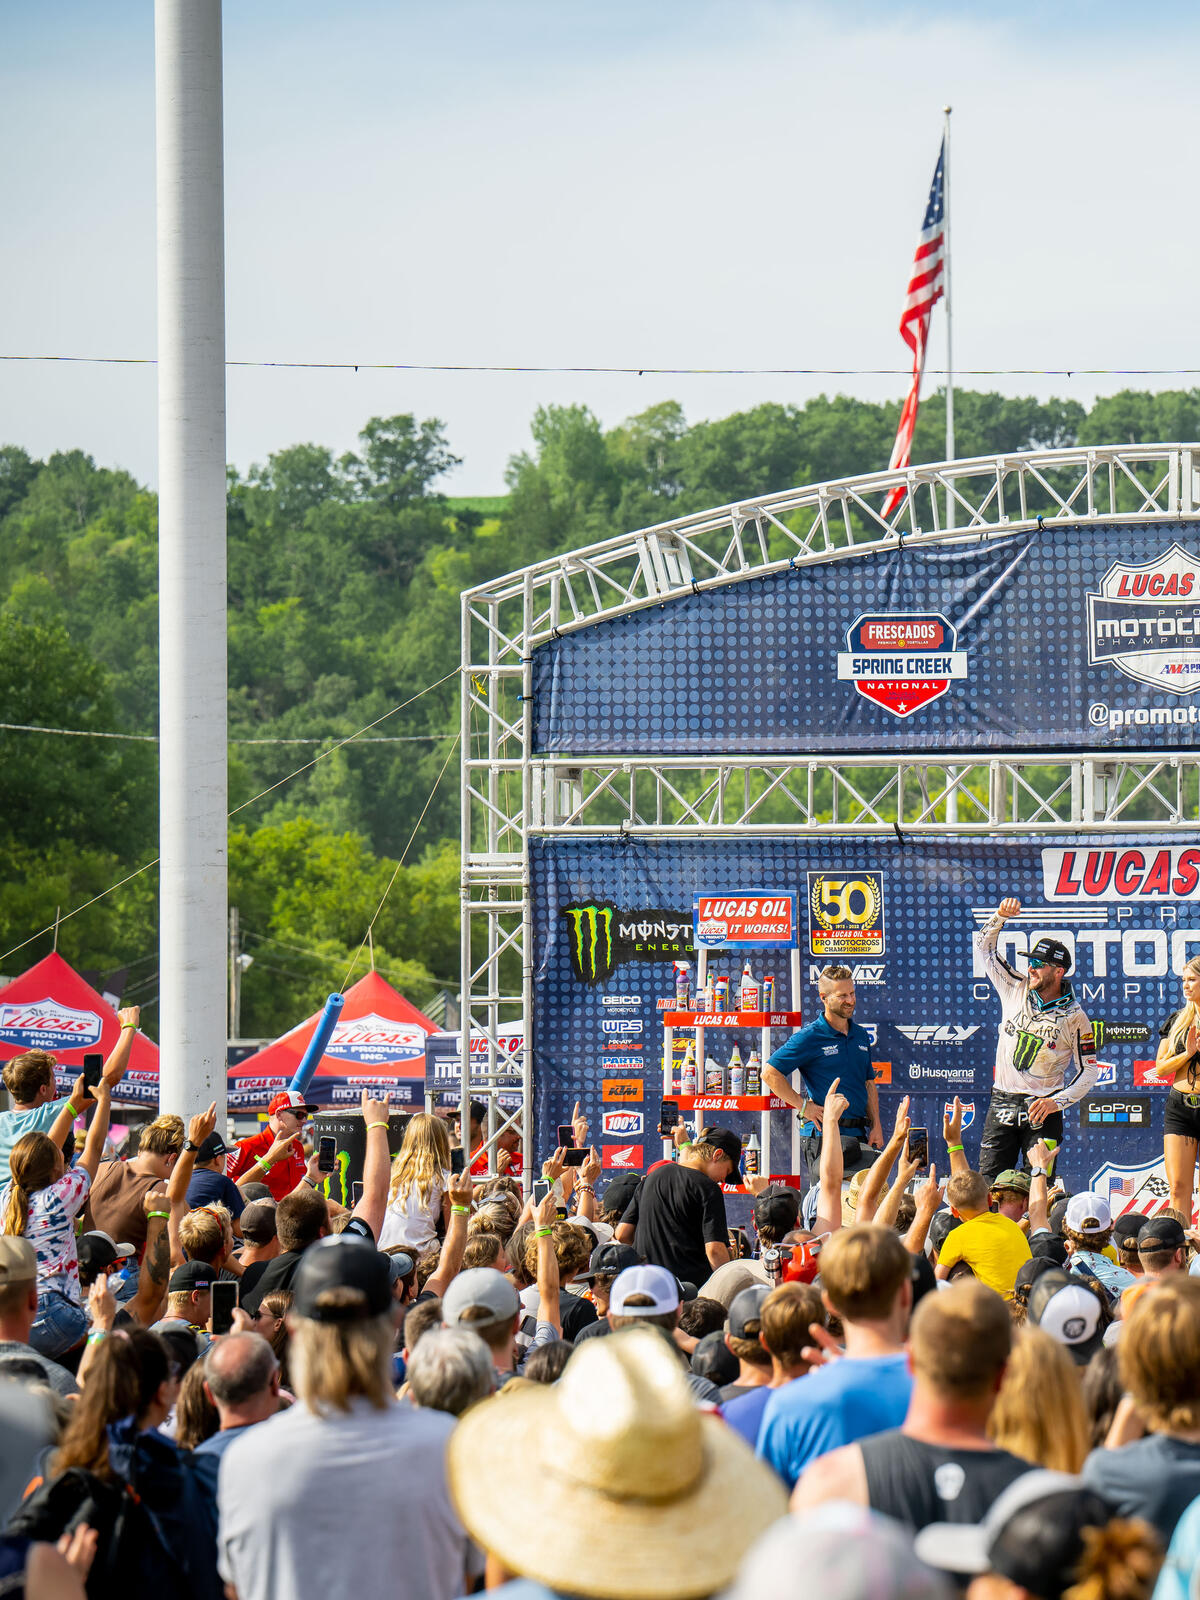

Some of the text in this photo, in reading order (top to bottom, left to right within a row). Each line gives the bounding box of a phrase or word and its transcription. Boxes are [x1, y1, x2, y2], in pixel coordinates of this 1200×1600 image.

[1117, 573, 1194, 597] LUCAS
[1158, 608, 1200, 616] PRO
[868, 624, 936, 640] FRESCADOS
[852, 657, 953, 675] SPRING CREEK
[867, 682, 939, 690] NATIONAL
[820, 881, 875, 925] 50
[703, 900, 788, 918] LUCAS OIL
[729, 924, 789, 934] IT WORKS!
[602, 996, 642, 1005] GEICO
[4, 1015, 92, 1032] LUCAS
[693, 1015, 740, 1026] LUCAS OIL
[602, 1020, 643, 1034] WPS
[1106, 1025, 1149, 1036] MONSTER
[22, 1030, 93, 1043] PRODUCTS
[333, 1032, 418, 1044] LUCAS
[895, 1025, 982, 1041] FLY
[31, 1039, 57, 1047] INC.
[325, 1045, 421, 1055] OIL PRODUCTS
[360, 1053, 387, 1061] INC.
[921, 1068, 974, 1079] Husqvarna
[238, 1078, 284, 1089] LUCAS OIL
[608, 1084, 638, 1096] KTM
[693, 1098, 739, 1109] LUCAS OIL
[1089, 1103, 1142, 1113] GoPro
[608, 1116, 638, 1131] 100%
[723, 1183, 739, 1192] OIL
